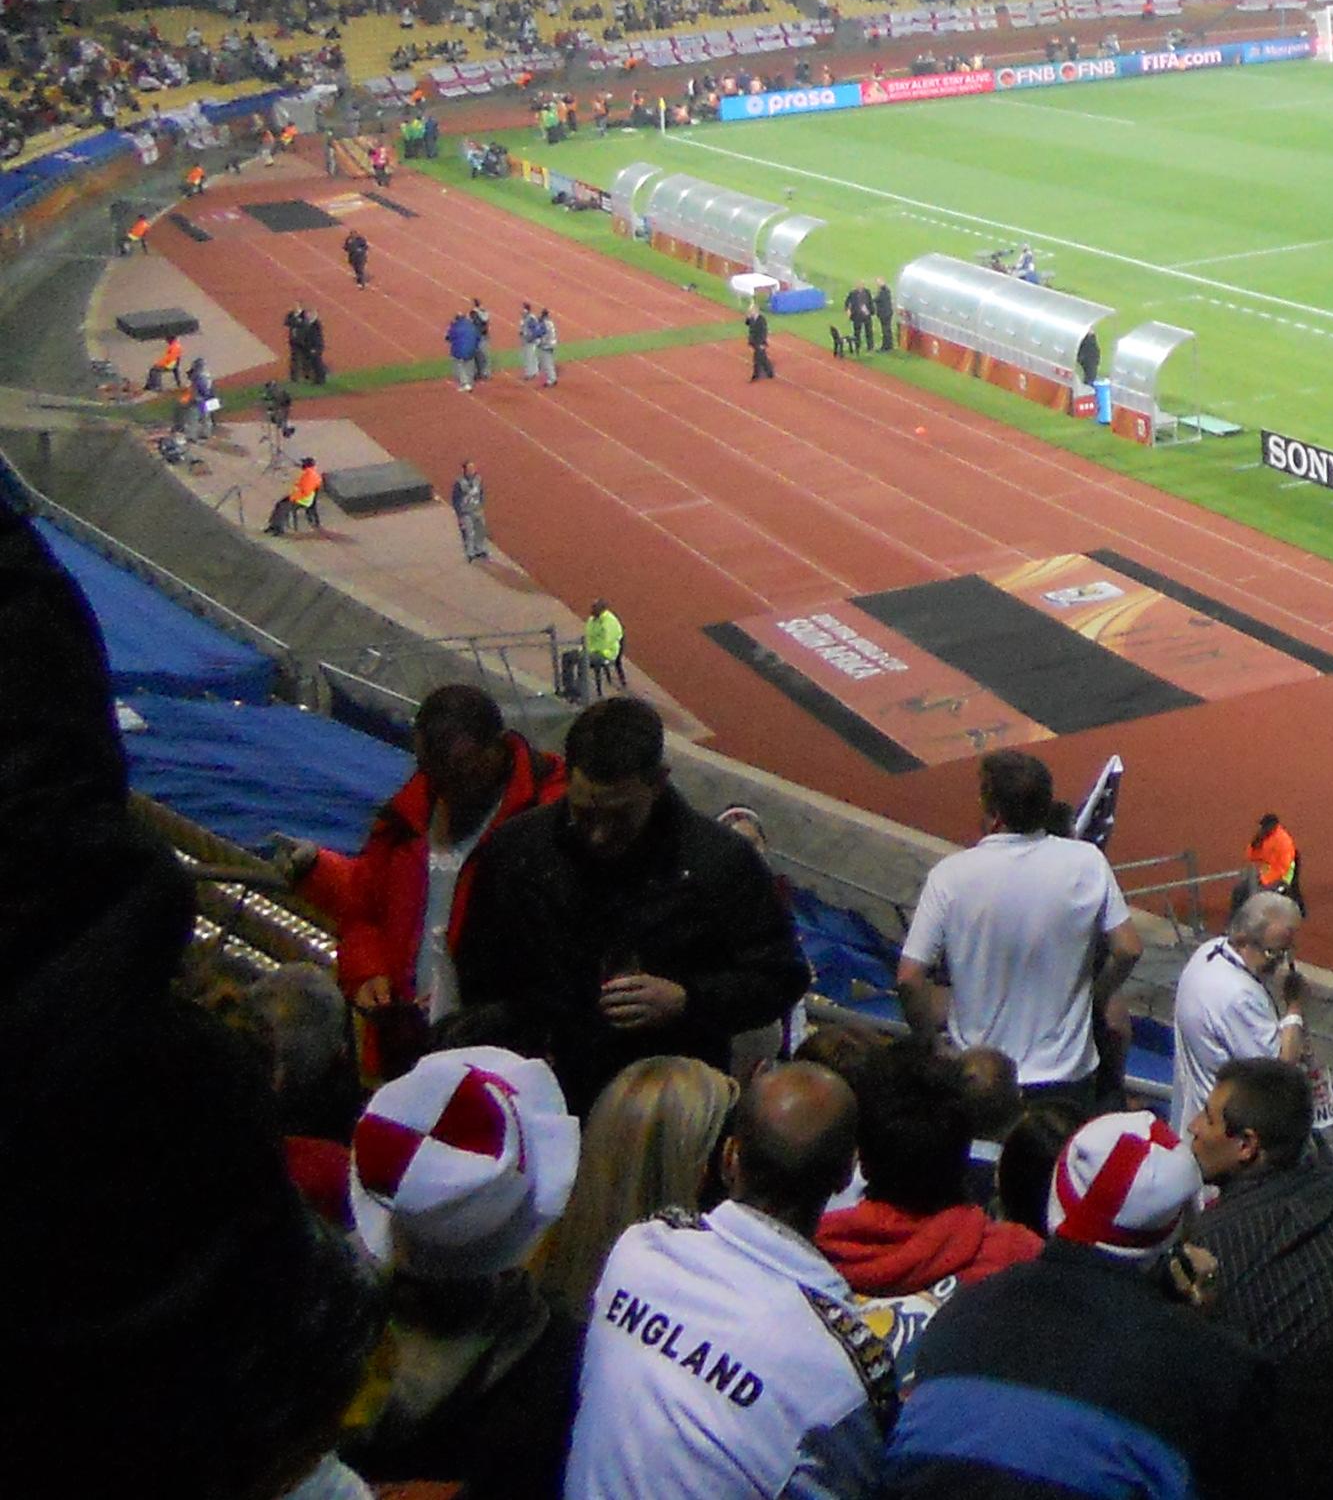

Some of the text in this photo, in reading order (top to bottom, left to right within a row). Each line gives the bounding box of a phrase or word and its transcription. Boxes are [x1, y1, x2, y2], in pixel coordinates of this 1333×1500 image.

[1075, 58, 1116, 78] FNB
[1141, 49, 1222, 71] FIFAcom
[1016, 65, 1056, 84] FNB
[767, 88, 837, 115] prasa
[605, 1288, 765, 1408] ENGLAND
